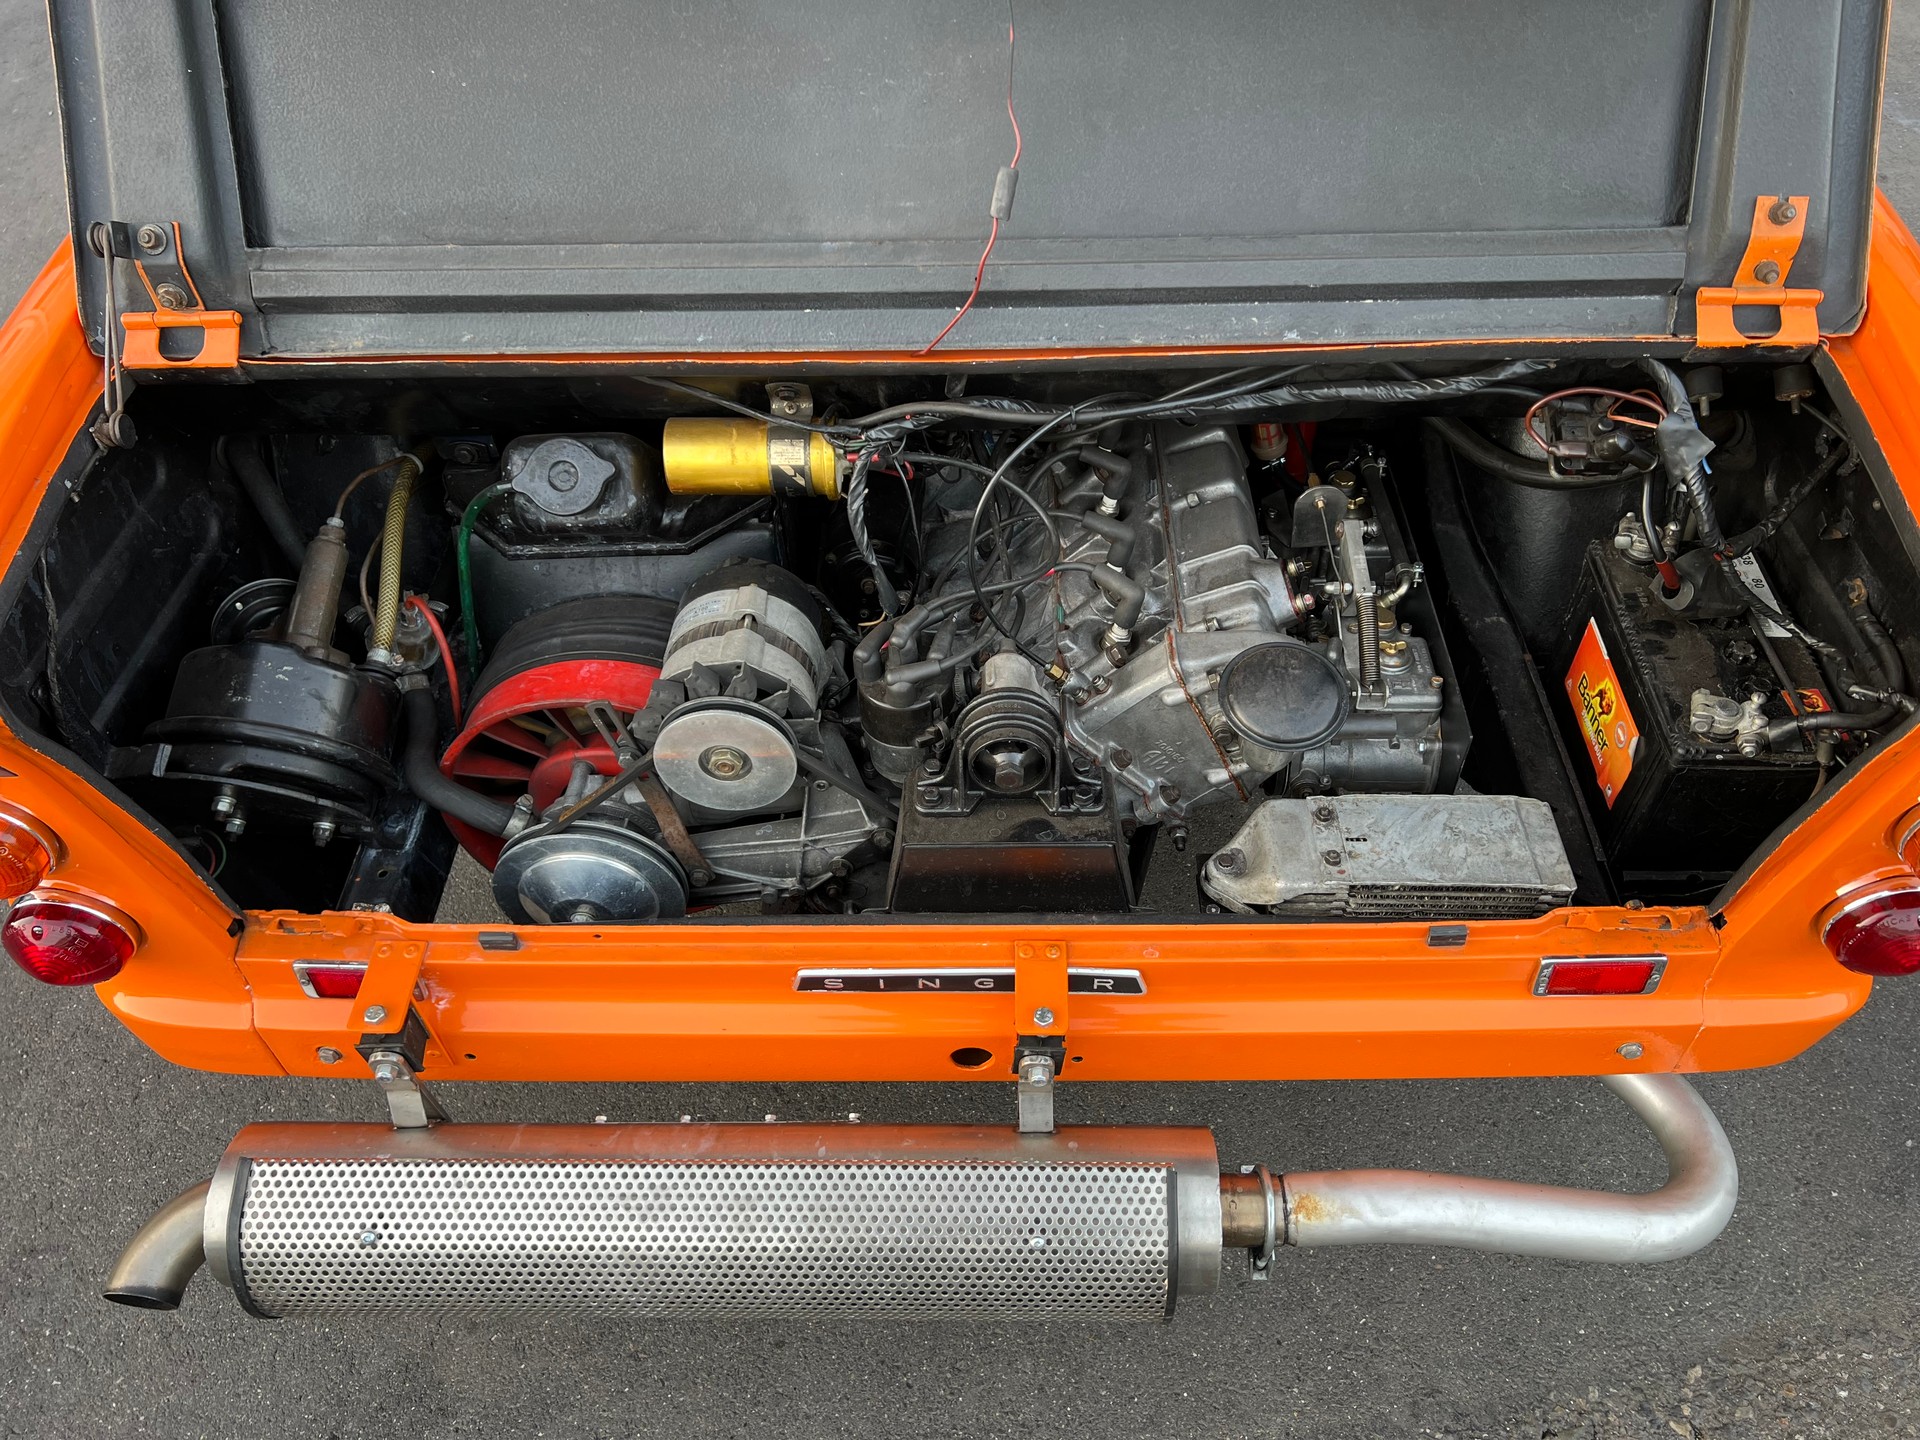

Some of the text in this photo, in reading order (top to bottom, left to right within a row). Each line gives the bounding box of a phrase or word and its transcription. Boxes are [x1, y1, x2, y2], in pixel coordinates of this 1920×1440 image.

[1751, 578, 1765, 589] 80
[1578, 673, 1610, 752] Banner
[1581, 709, 1603, 766] STARTING BULL
[823, 977, 1114, 990] SINGR
